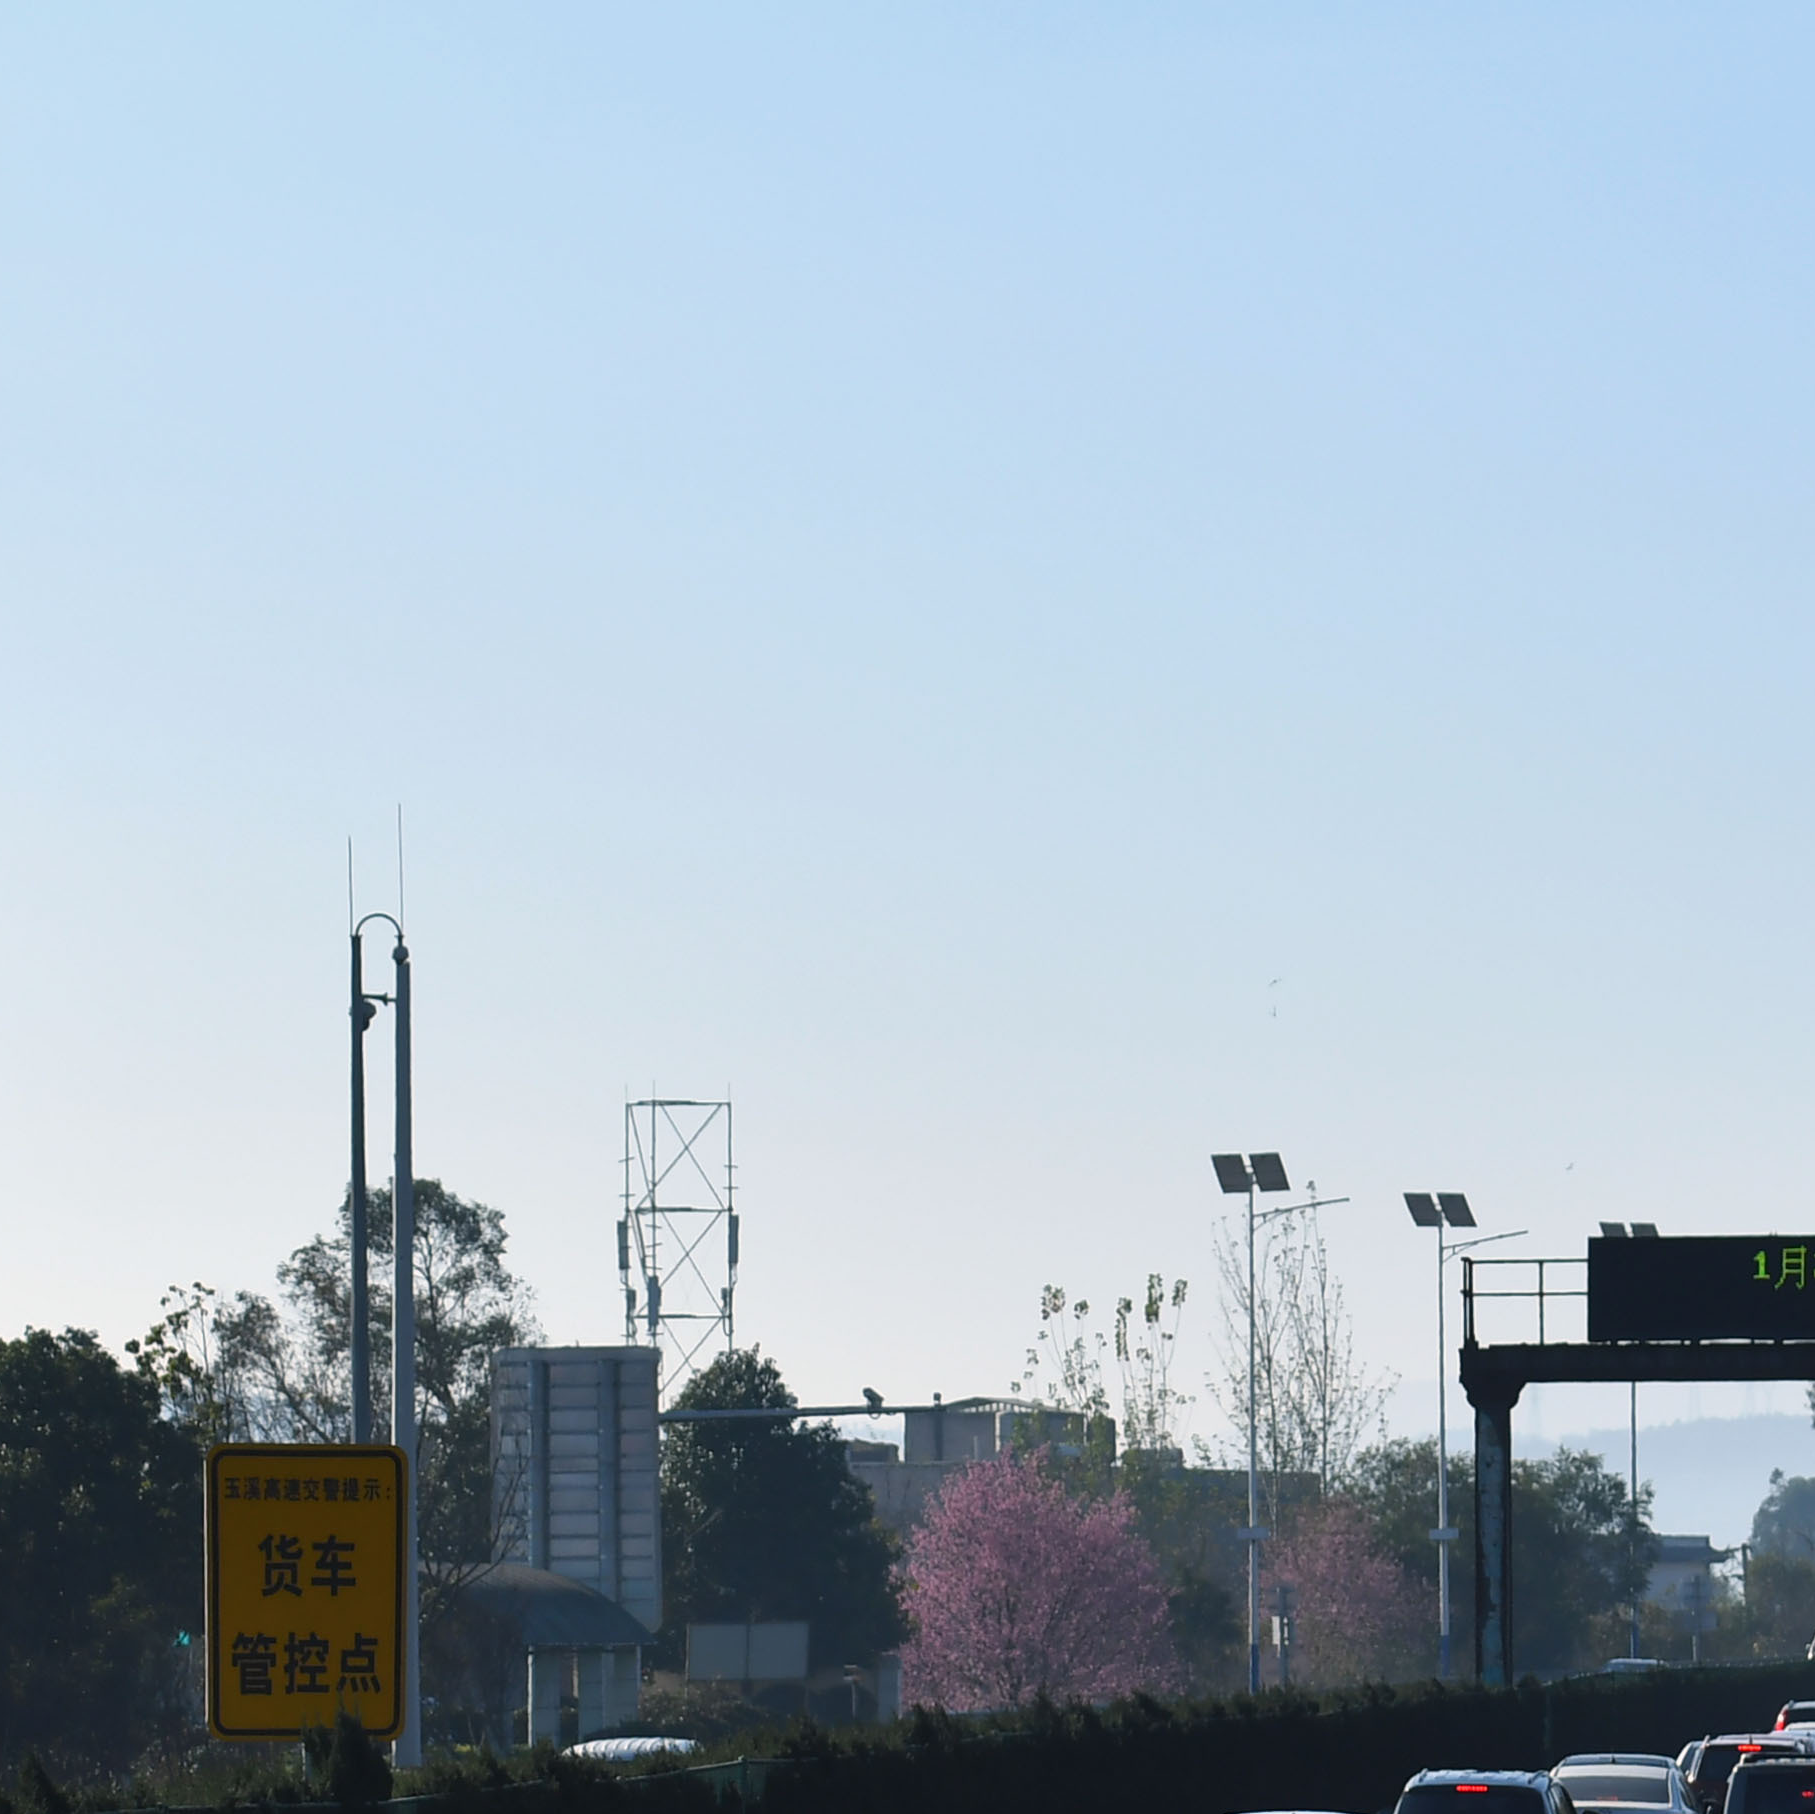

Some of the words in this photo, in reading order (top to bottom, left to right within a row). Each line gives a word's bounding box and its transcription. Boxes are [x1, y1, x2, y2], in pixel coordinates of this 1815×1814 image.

[258, 1534, 356, 1597] 货车
[231, 1631, 381, 1695] 管控点
